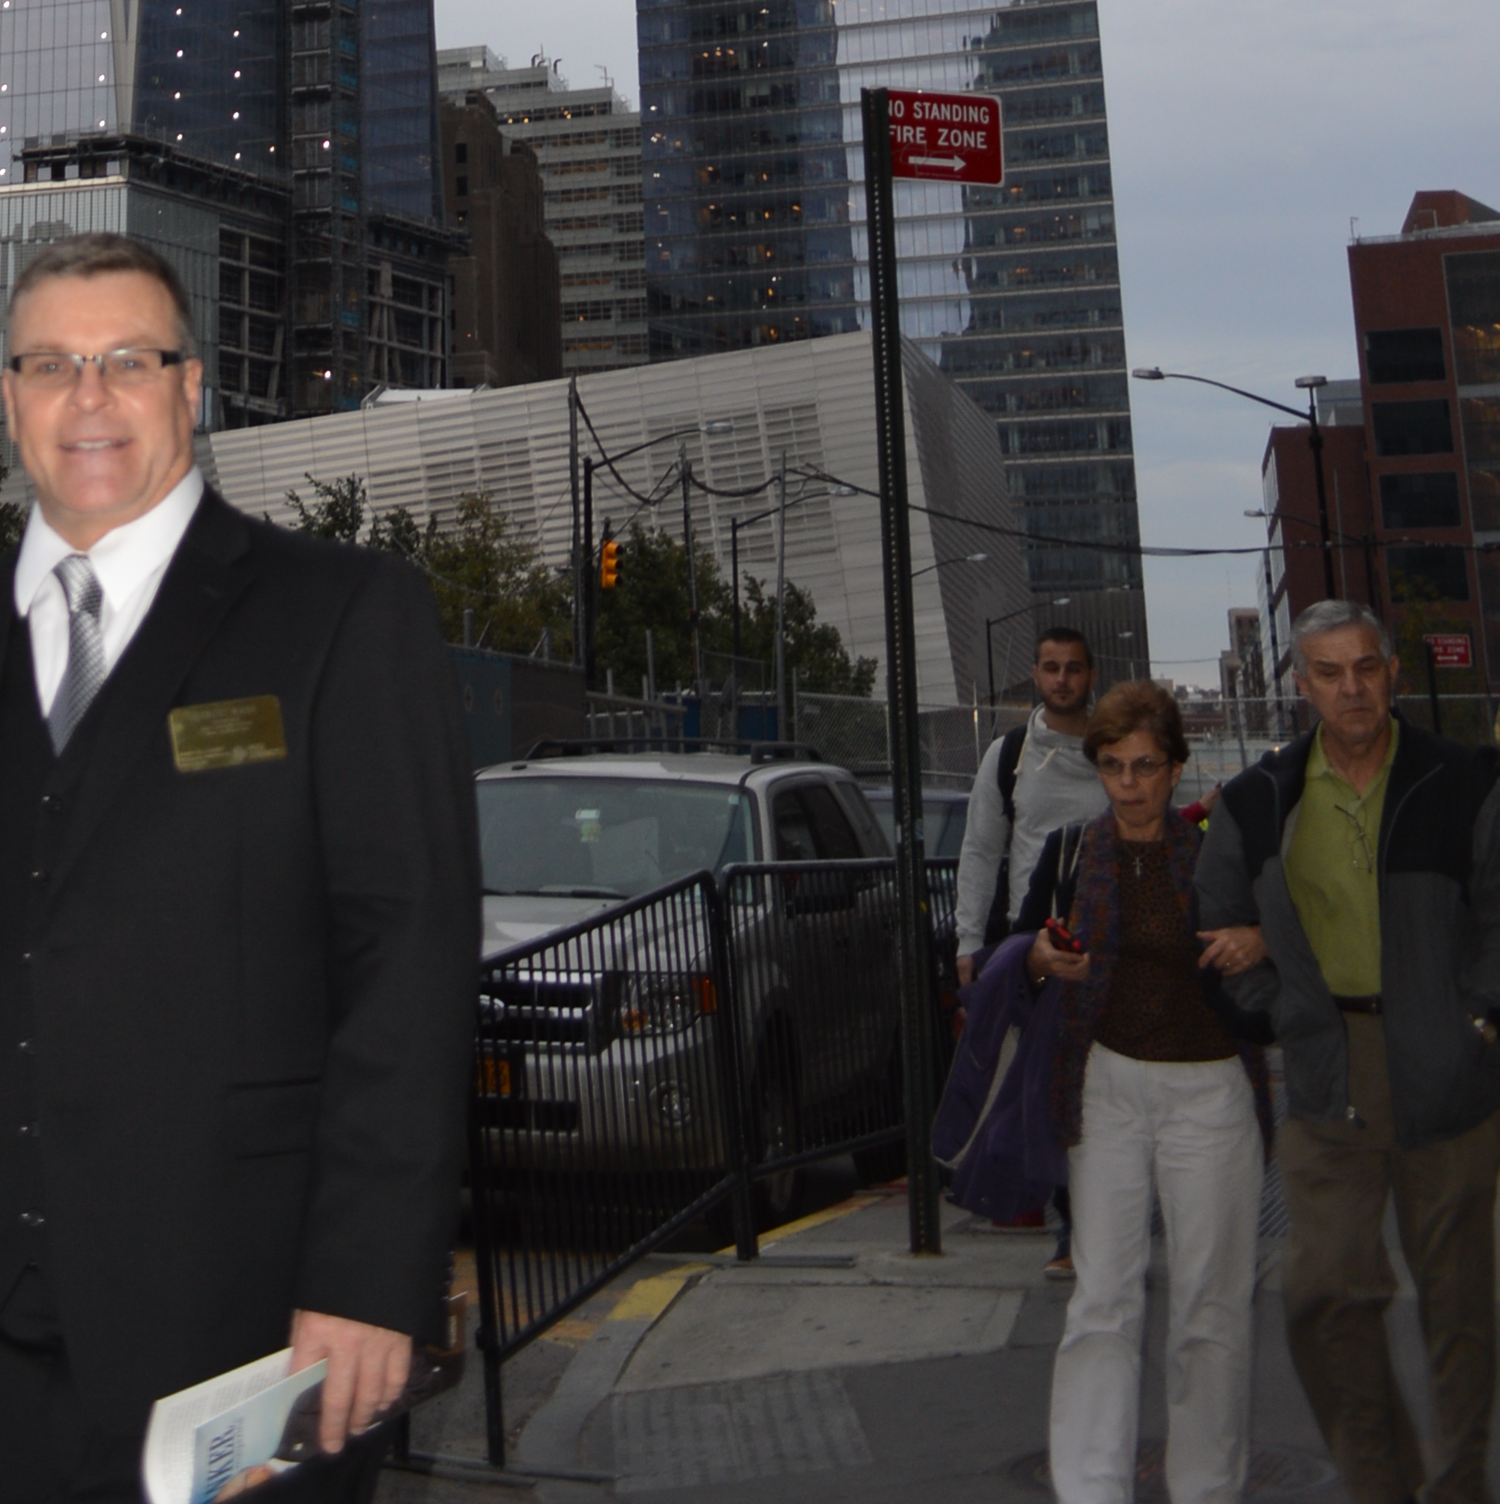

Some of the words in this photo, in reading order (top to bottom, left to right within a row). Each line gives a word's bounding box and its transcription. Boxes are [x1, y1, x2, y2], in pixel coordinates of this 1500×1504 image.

[913, 101, 990, 124] STANDING
[888, 125, 927, 144] FIRE
[937, 128, 988, 149] ZONE
